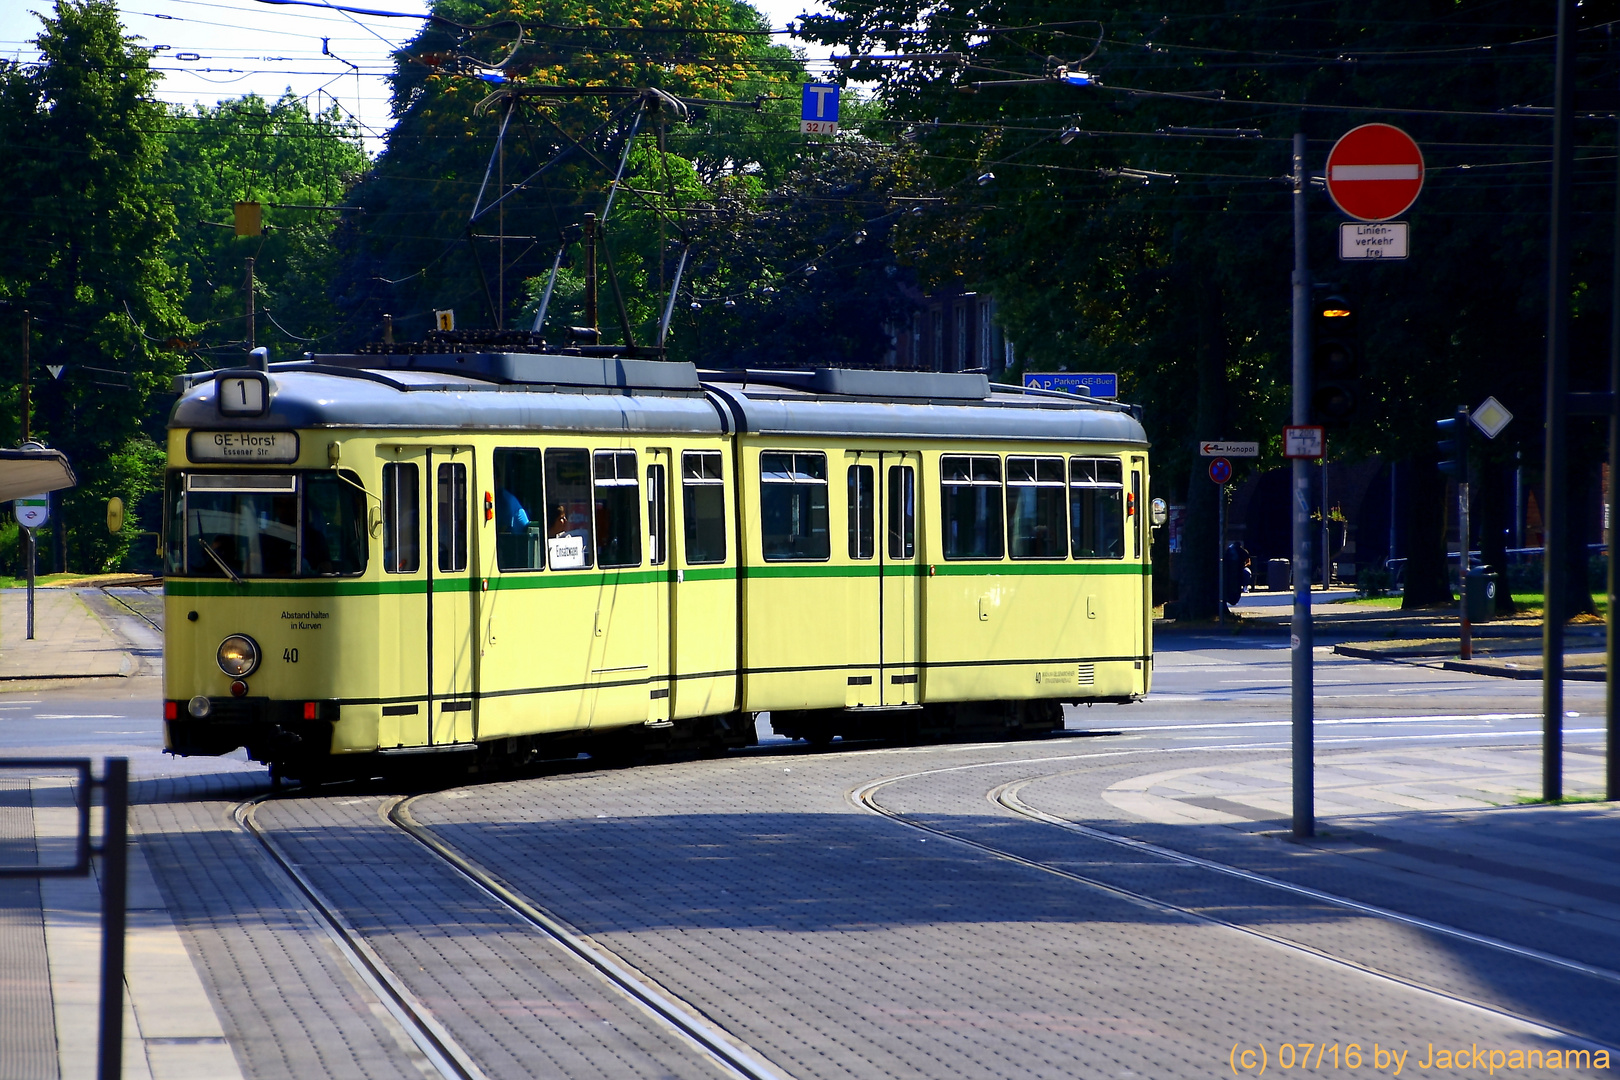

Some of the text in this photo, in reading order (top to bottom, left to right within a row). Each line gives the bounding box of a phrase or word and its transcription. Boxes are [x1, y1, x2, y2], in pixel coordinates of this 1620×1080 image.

[809, 86, 833, 118] T
[806, 123, 818, 132] 32
[1357, 226, 1392, 235] Linien-
[1356, 237, 1393, 246] verkehr
[1366, 248, 1383, 257] frei
[440, 314, 448, 330] 1
[1054, 377, 1113, 385] Parken GE-Buer
[237, 380, 247, 405] 1
[214, 433, 276, 446] GE-Horst
[223, 448, 253, 456] Essener
[1226, 445, 1255, 454] Monopol
[280, 611, 330, 619] Abstand halten
[290, 621, 322, 630] in Kurven
[282, 648, 299, 663] 40
